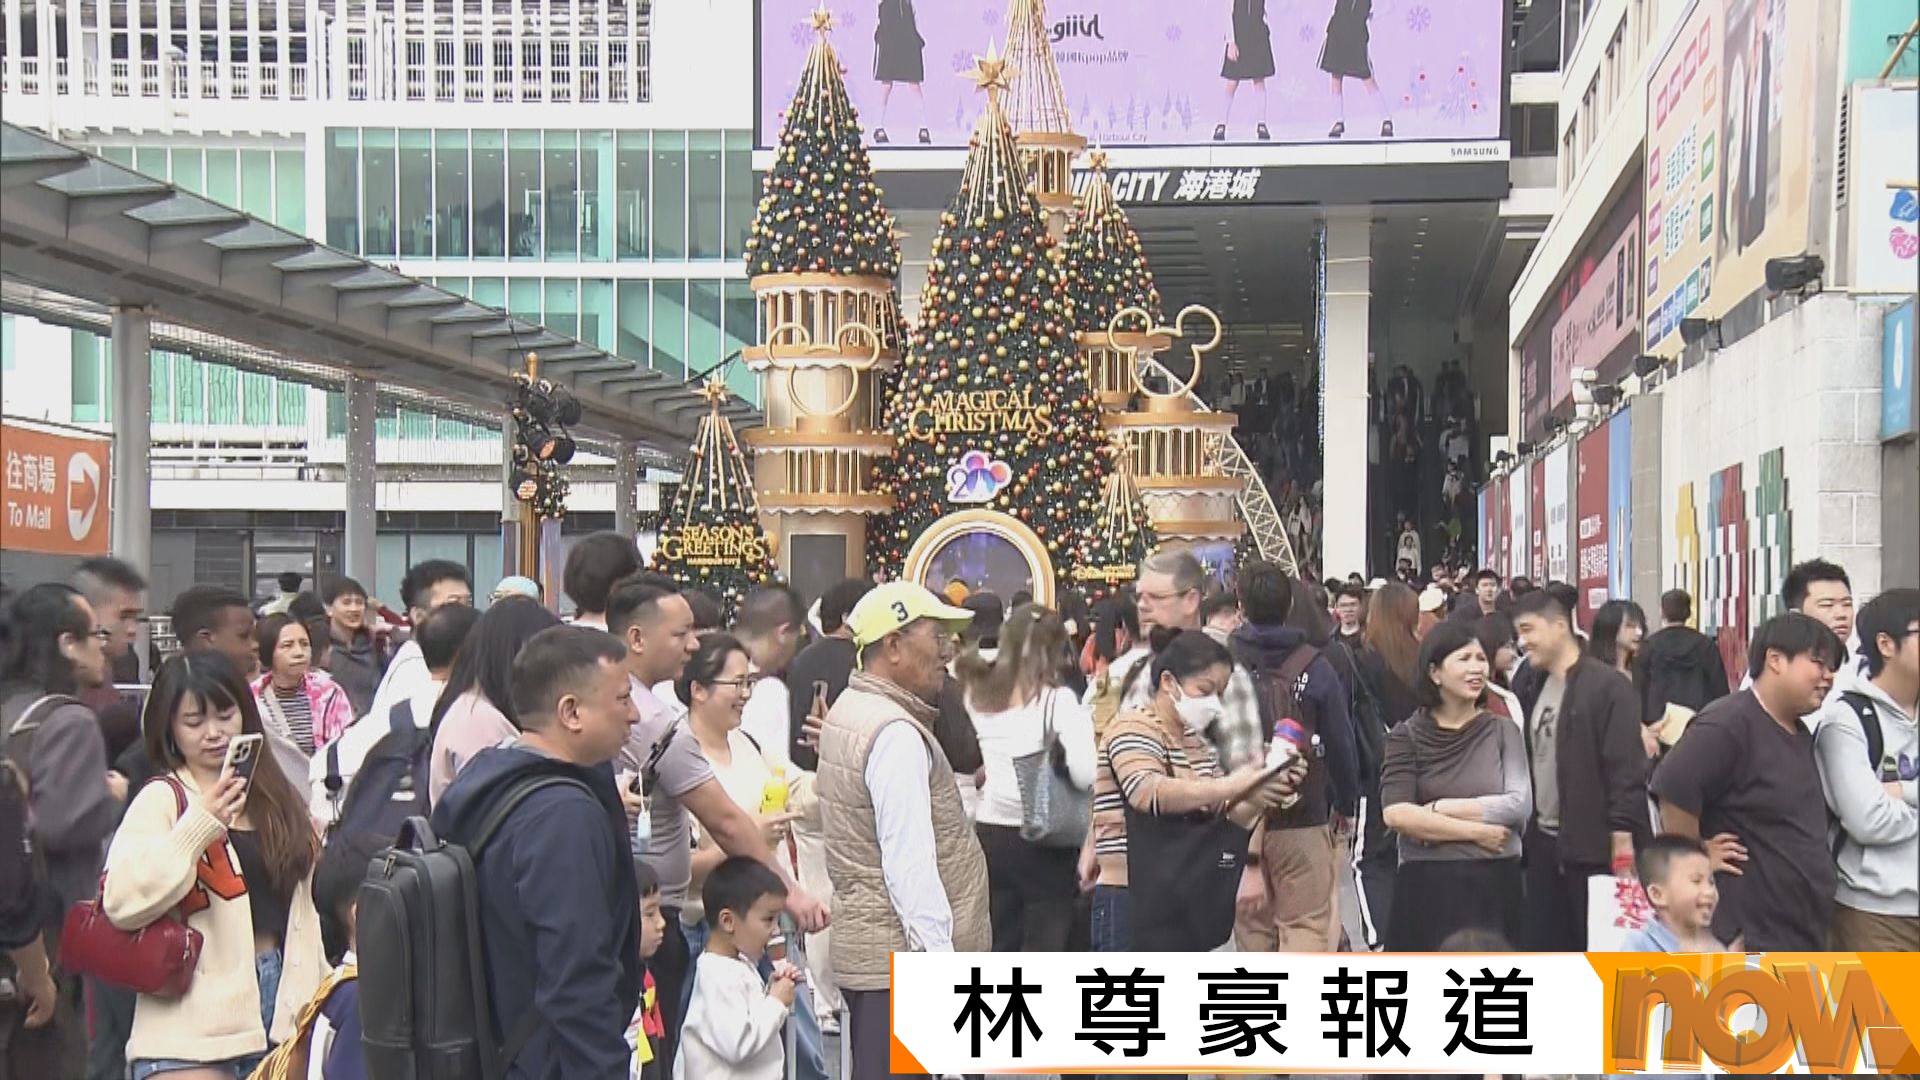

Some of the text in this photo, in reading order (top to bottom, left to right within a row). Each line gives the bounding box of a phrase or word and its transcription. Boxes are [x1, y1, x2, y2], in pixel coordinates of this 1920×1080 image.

[1450, 147, 1499, 157] SAMSUNG
[1113, 172, 1170, 201] CITY
[1174, 168, 1262, 200] 海港城
[933, 390, 1037, 413] MAGICAL
[908, 404, 1053, 440] CHRISTMAS
[6, 449, 56, 495] 往商場
[7, 501, 52, 530] To Mall
[662, 536, 765, 562] GREETINGS
[891, 601, 909, 623] 3
